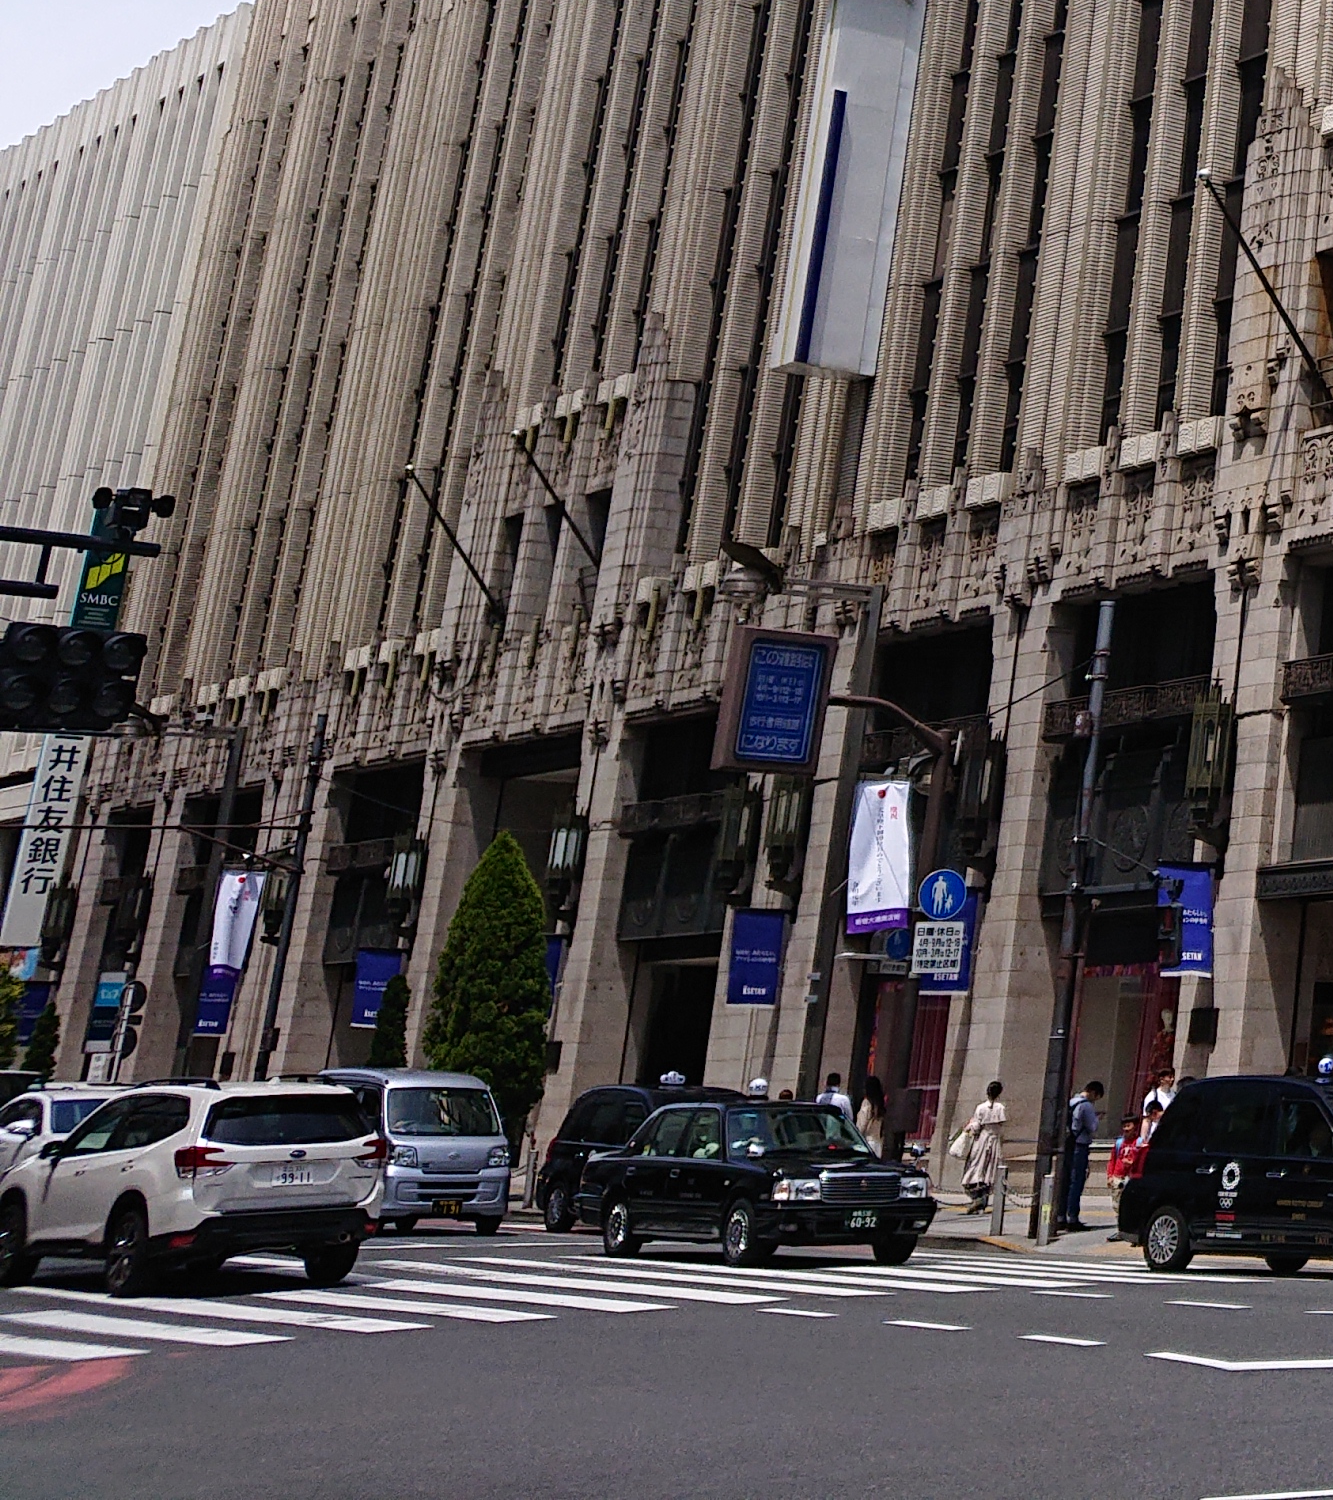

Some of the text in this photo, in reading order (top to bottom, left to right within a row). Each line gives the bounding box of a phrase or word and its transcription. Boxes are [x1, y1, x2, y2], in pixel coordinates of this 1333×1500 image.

[80, 593, 119, 607] SMBC
[20, 735, 84, 894] 井住友銀行
[1182, 952, 1202, 961] SETAN
